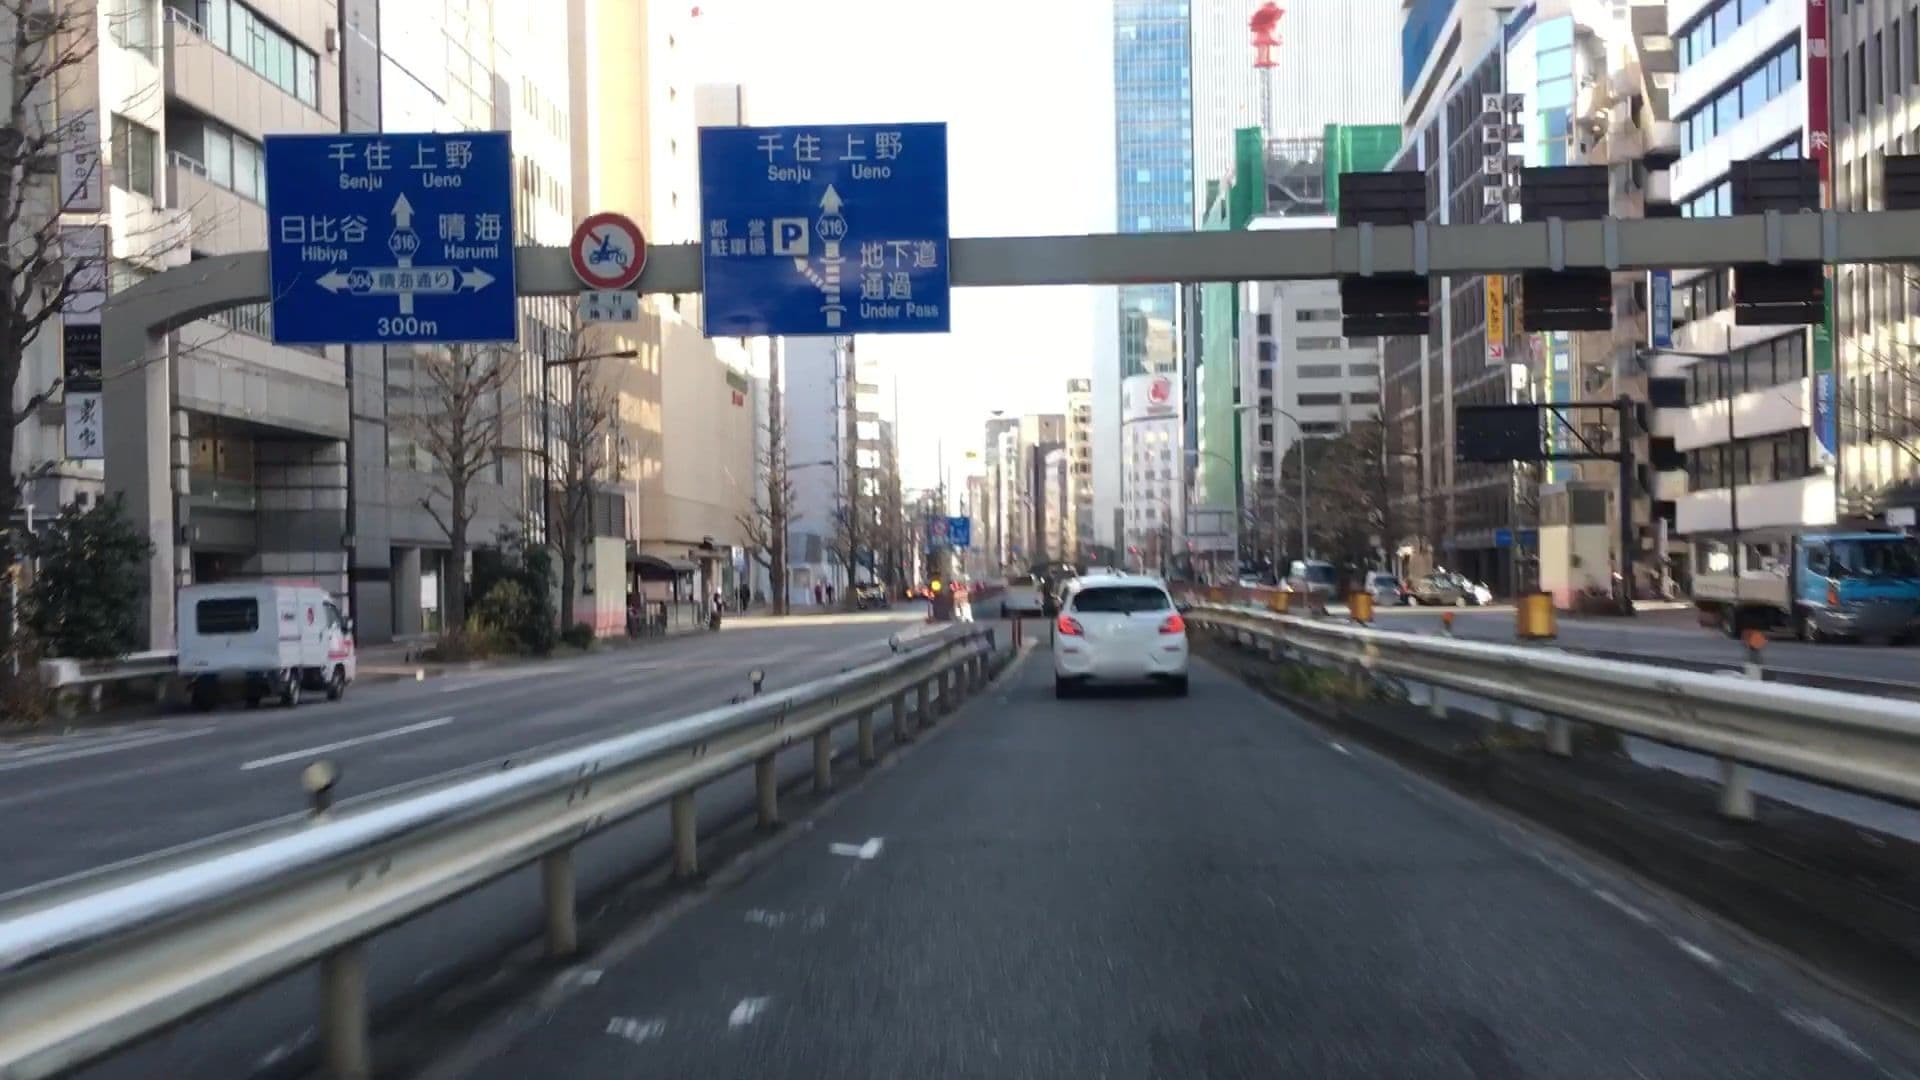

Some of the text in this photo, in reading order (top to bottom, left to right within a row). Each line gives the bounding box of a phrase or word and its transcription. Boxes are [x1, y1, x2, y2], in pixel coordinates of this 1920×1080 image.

[328, 140, 472, 170] 千住 上野
[757, 132, 902, 162] 千住 上野
[767, 164, 891, 181] Senju Ueno
[339, 173, 462, 191] Senju Ueno
[281, 215, 368, 243] 日比谷
[439, 212, 502, 241] 晴海
[780, 222, 803, 249] P
[820, 219, 842, 235] 316
[394, 235, 415, 250] 316
[301, 245, 348, 263] Hibiya
[444, 244, 498, 260] Harumi
[860, 240, 937, 268] 地下道
[860, 271, 912, 300] 通過
[860, 303, 939, 319] Under Pass
[378, 318, 438, 336] 300m
